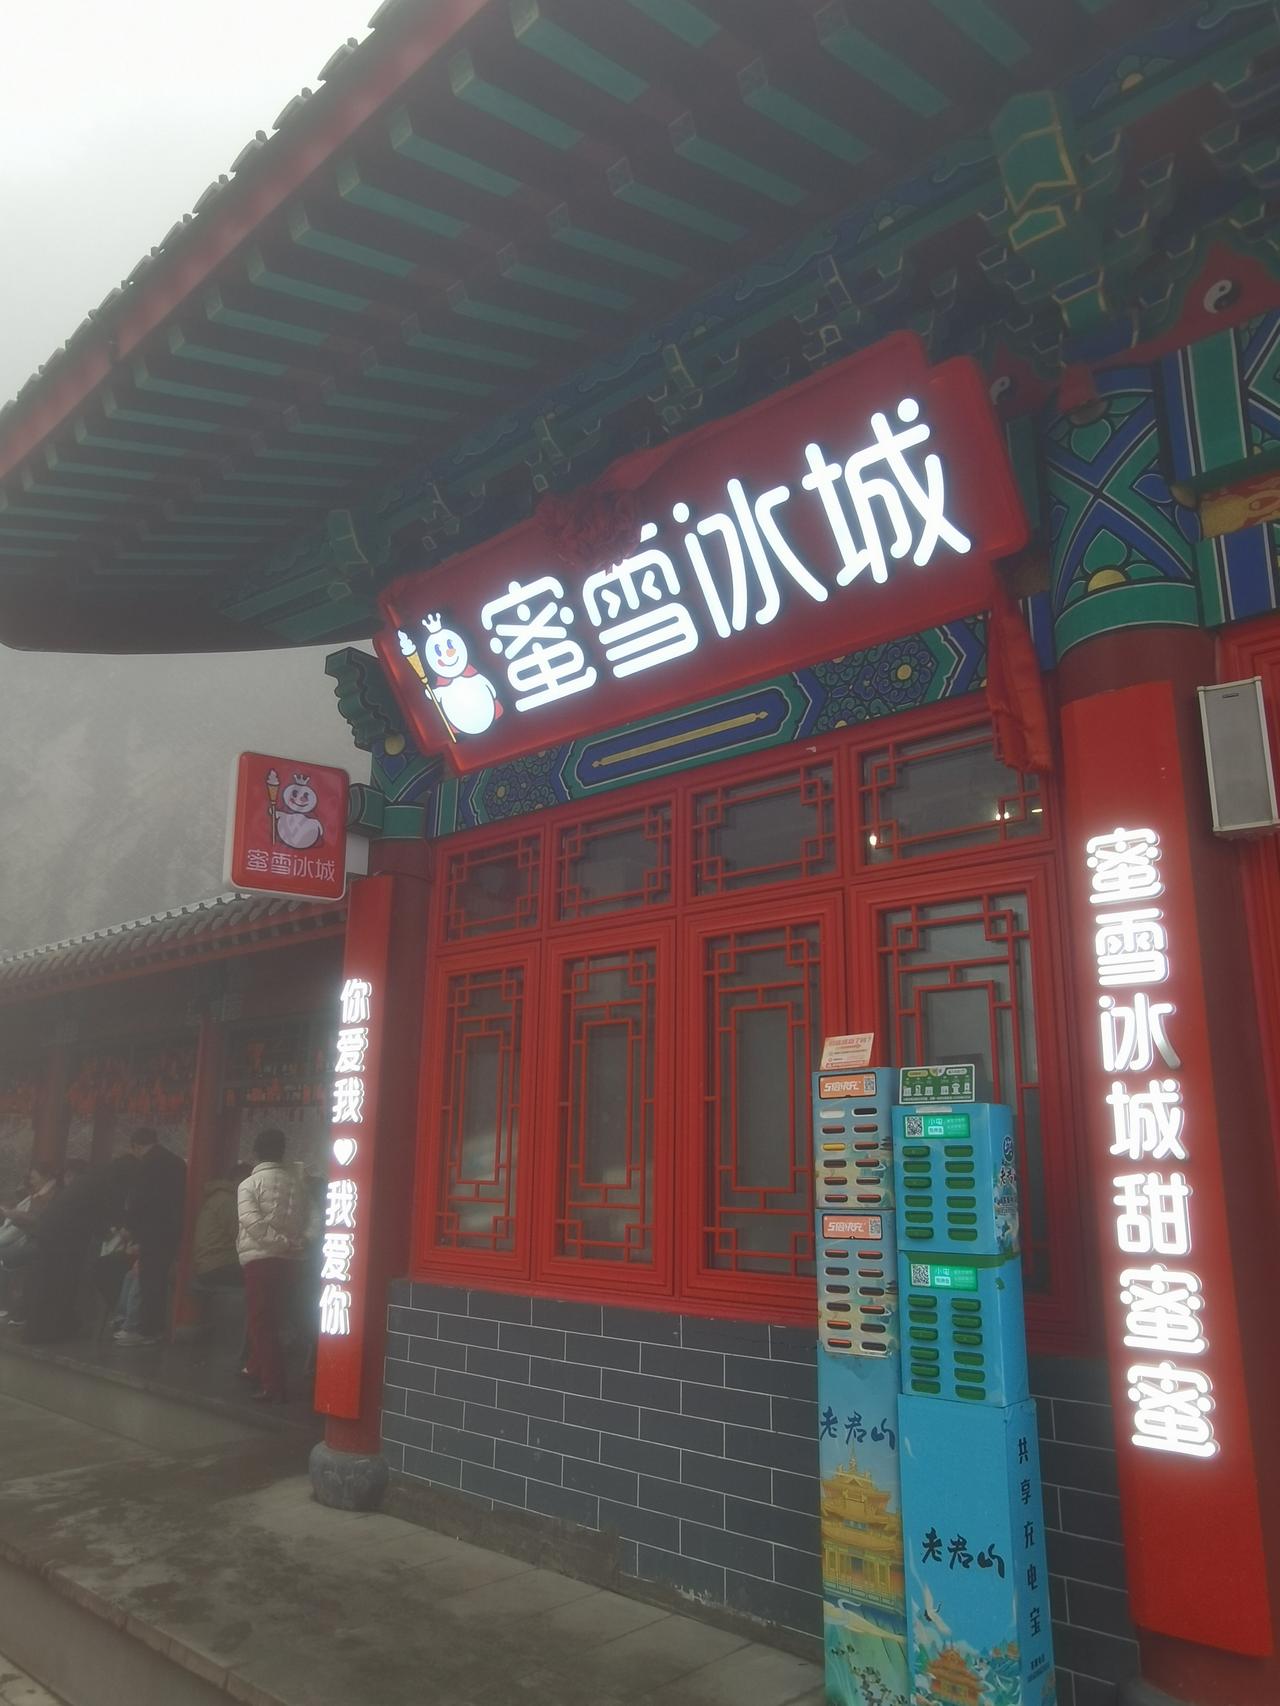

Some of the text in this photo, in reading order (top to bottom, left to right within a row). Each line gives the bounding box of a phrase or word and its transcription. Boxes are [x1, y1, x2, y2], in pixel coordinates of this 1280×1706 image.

[481, 397, 971, 713] 蜜雪冰城
[245, 849, 335, 882] 蜜雪冰城
[1086, 826, 1220, 1460] 蜜雪冰城甜蜜蜜
[819, 1405, 896, 1450] 老君山
[921, 1526, 1005, 1579] 老君山
[1017, 1436, 1042, 1638] 共享充电宝
